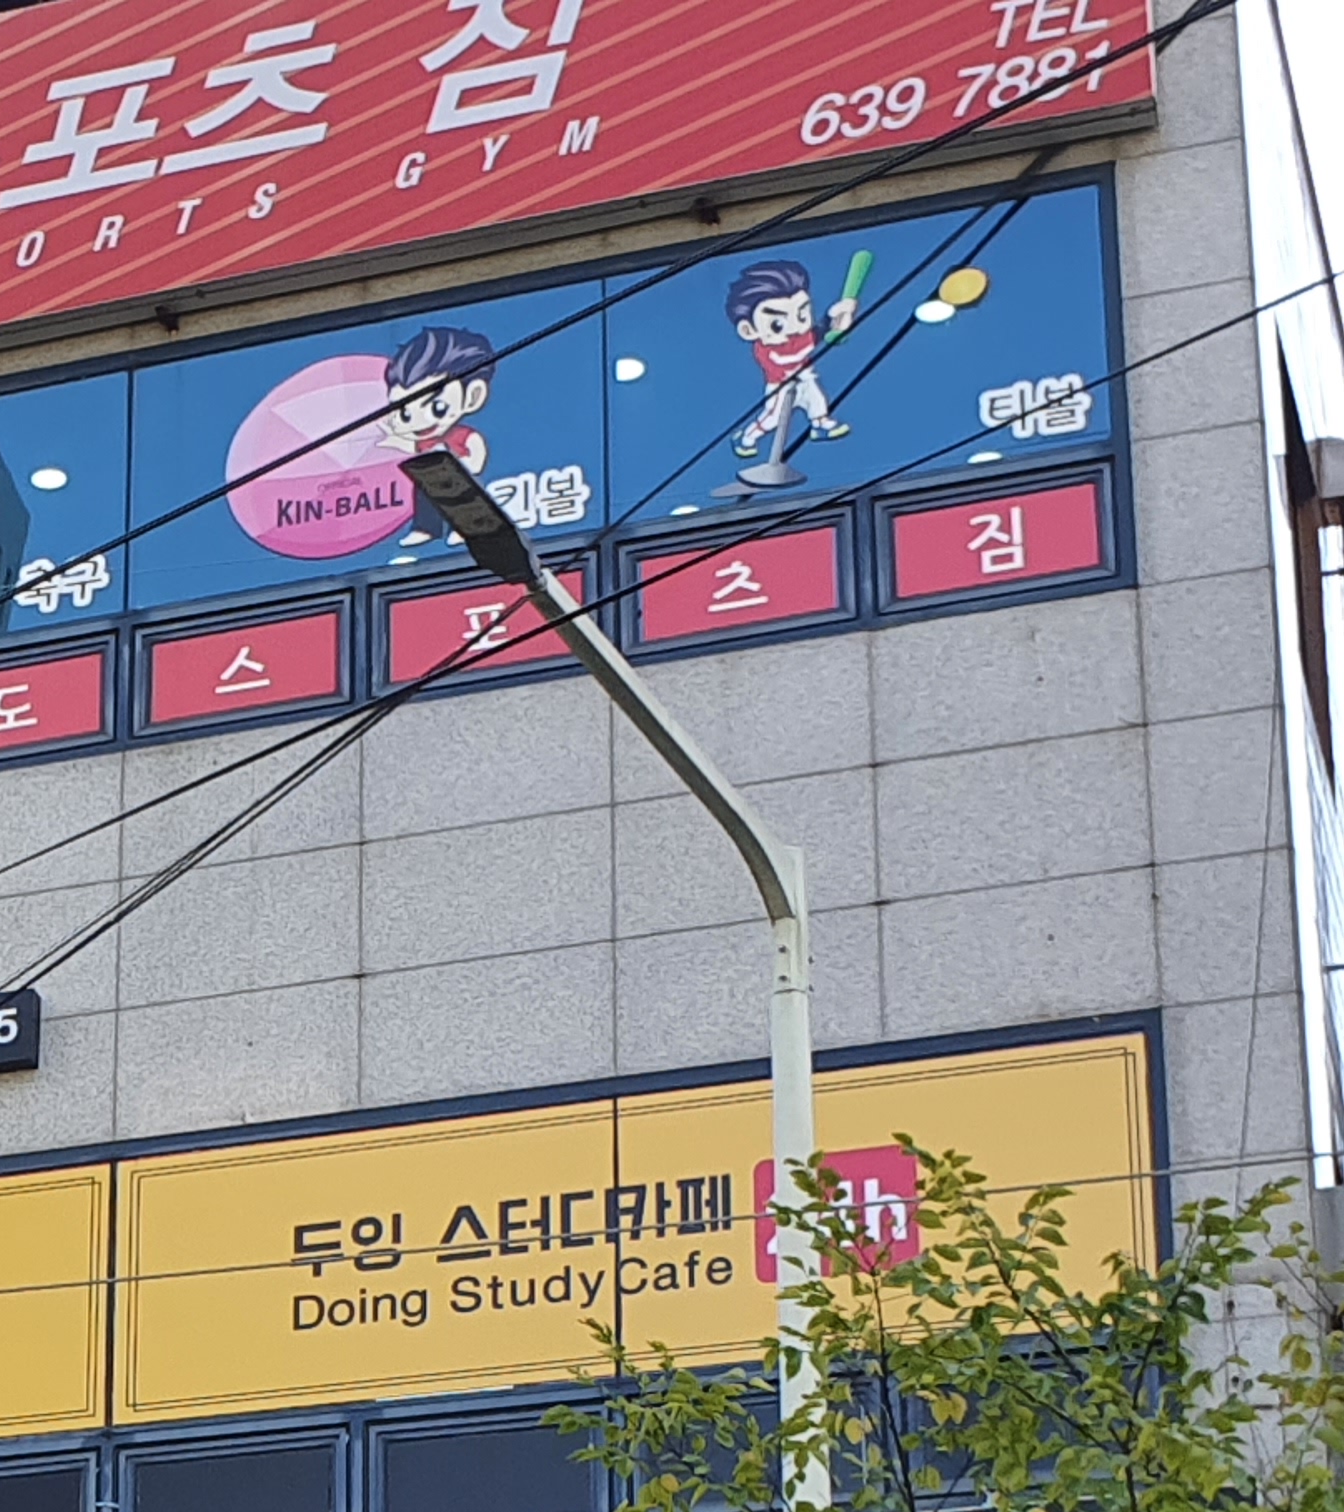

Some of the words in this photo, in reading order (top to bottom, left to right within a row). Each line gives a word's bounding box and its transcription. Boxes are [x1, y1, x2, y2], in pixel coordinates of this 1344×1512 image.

[990, 0, 1110, 48] TEL
[417, 0, 582, 135] 짐
[800, 77, 927, 146] 639
[953, 40, 1110, 119] 7881
[394, 116, 600, 190] GYM
[277, 480, 404, 528] KIN-BALL
[292, 1213, 404, 1277] 두잉
[435, 1171, 732, 1263] 스터디카페
[292, 1283, 429, 1332] Doing
[449, 1264, 605, 1315] Study
[615, 1248, 734, 1298] Cafe
